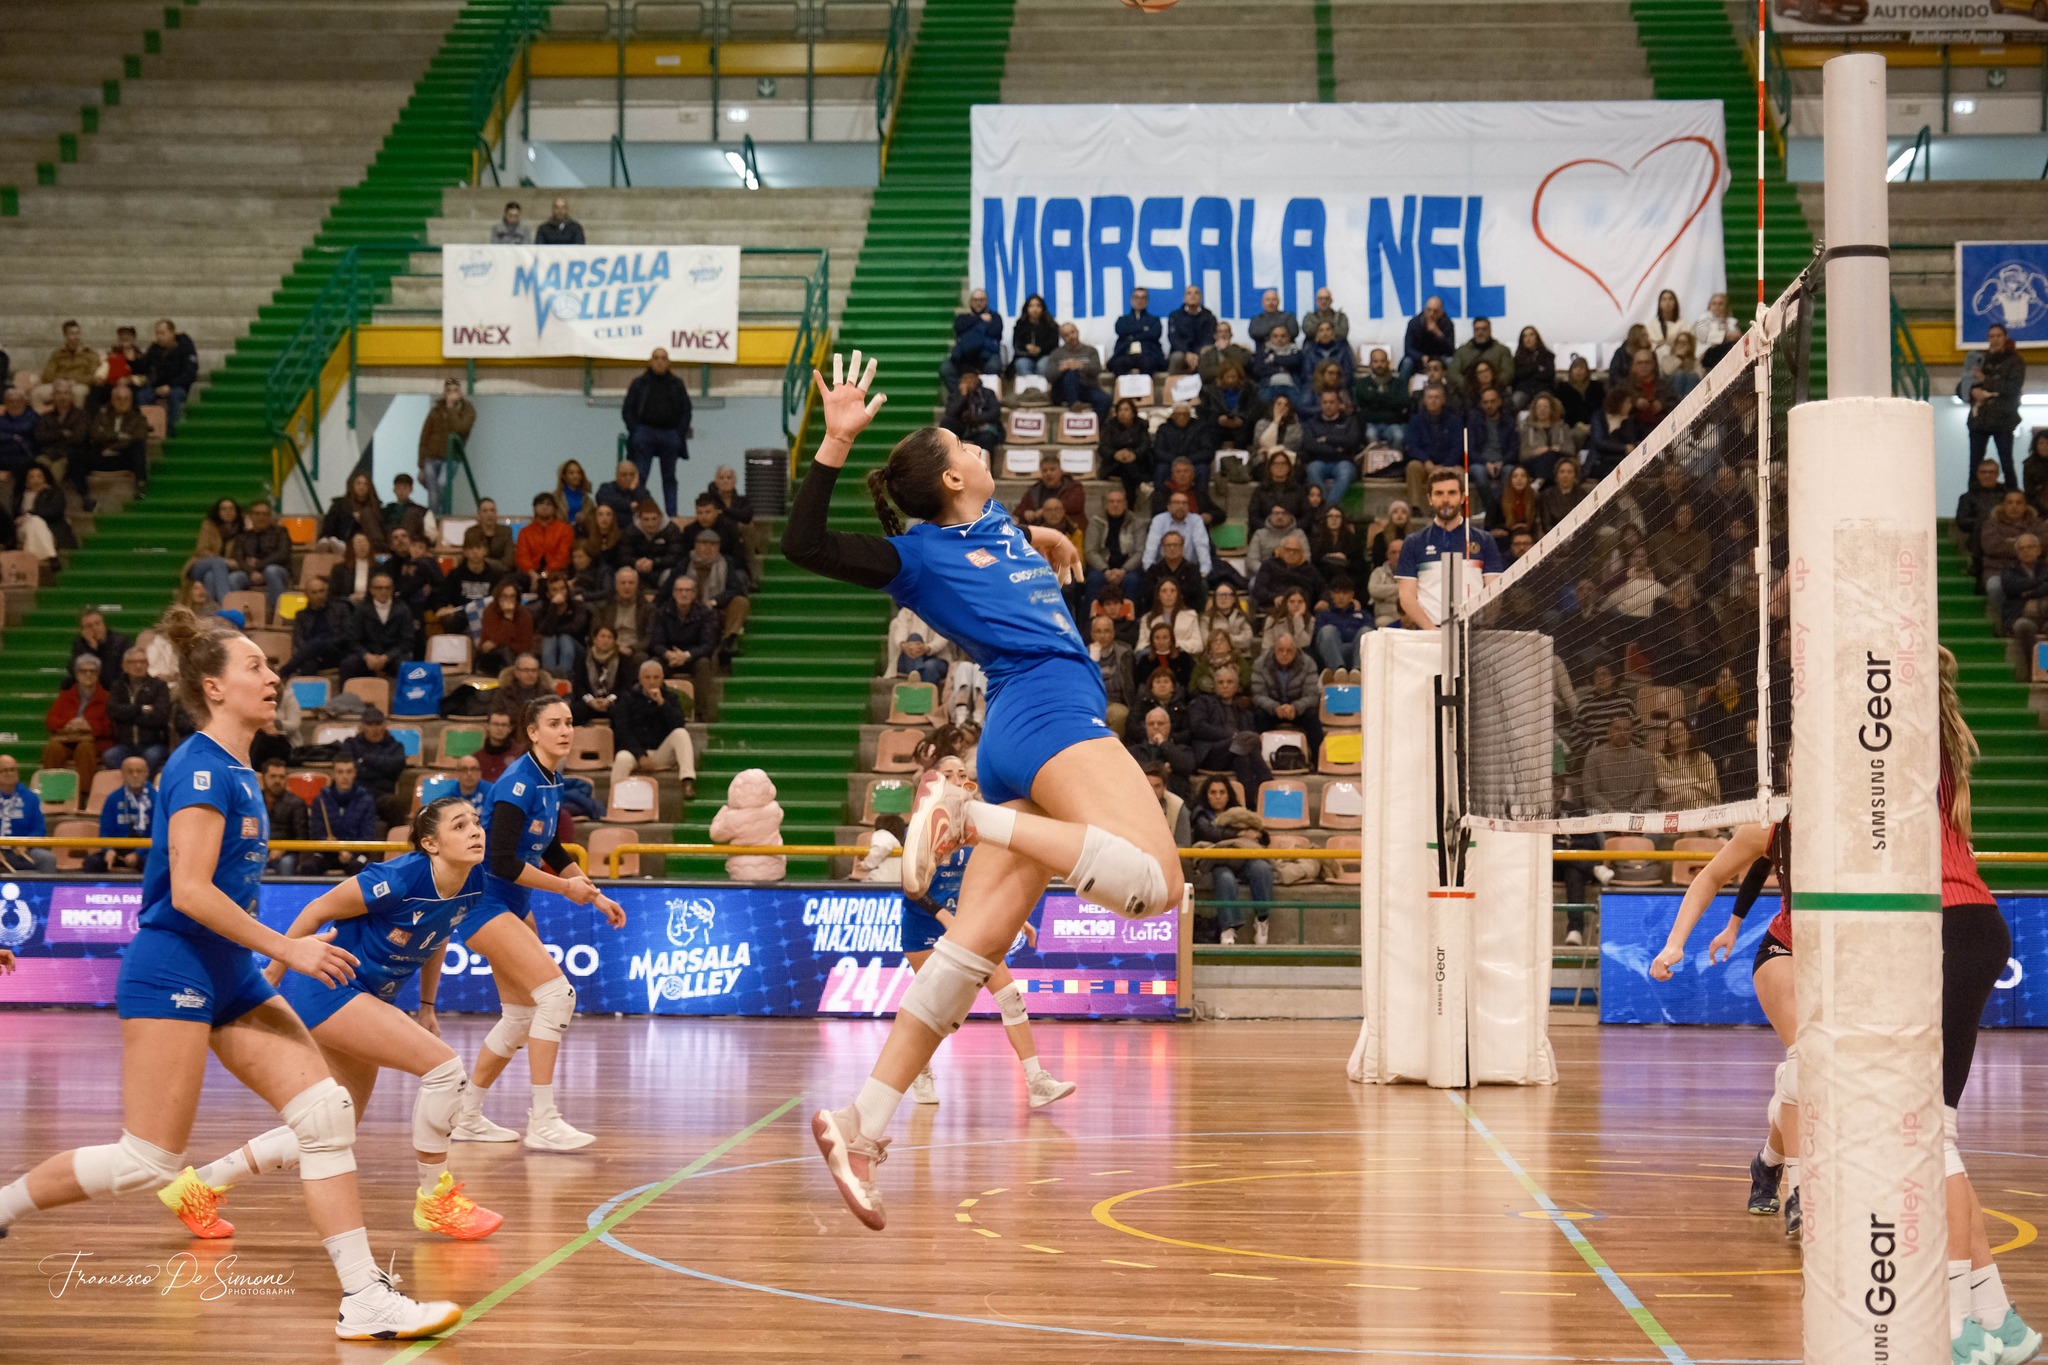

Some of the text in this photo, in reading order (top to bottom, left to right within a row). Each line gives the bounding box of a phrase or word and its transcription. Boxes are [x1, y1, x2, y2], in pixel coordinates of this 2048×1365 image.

[1873, 4, 1989, 19] AUTOMONDO
[513, 250, 671, 297] MARSALA
[983, 195, 1507, 319] MARSALA NEL
[534, 283, 659, 338] VOLLEY
[594, 324, 644, 339] CLUB
[452, 325, 511, 345] IMEX
[671, 329, 730, 350] IMEX
[1858, 650, 1892, 851] SAMSUNG Gear
[85, 894, 121, 904] MEDIA
[419, 931, 436, 950] 8
[628, 942, 751, 981] MARSALA
[1435, 945, 1446, 982] Gear
[645, 967, 743, 1012] VOLLEY
[825, 955, 916, 1017] 24/
[1900, 1177, 1924, 1259] Volley
[1865, 1212, 1897, 1365] UNG Gear
